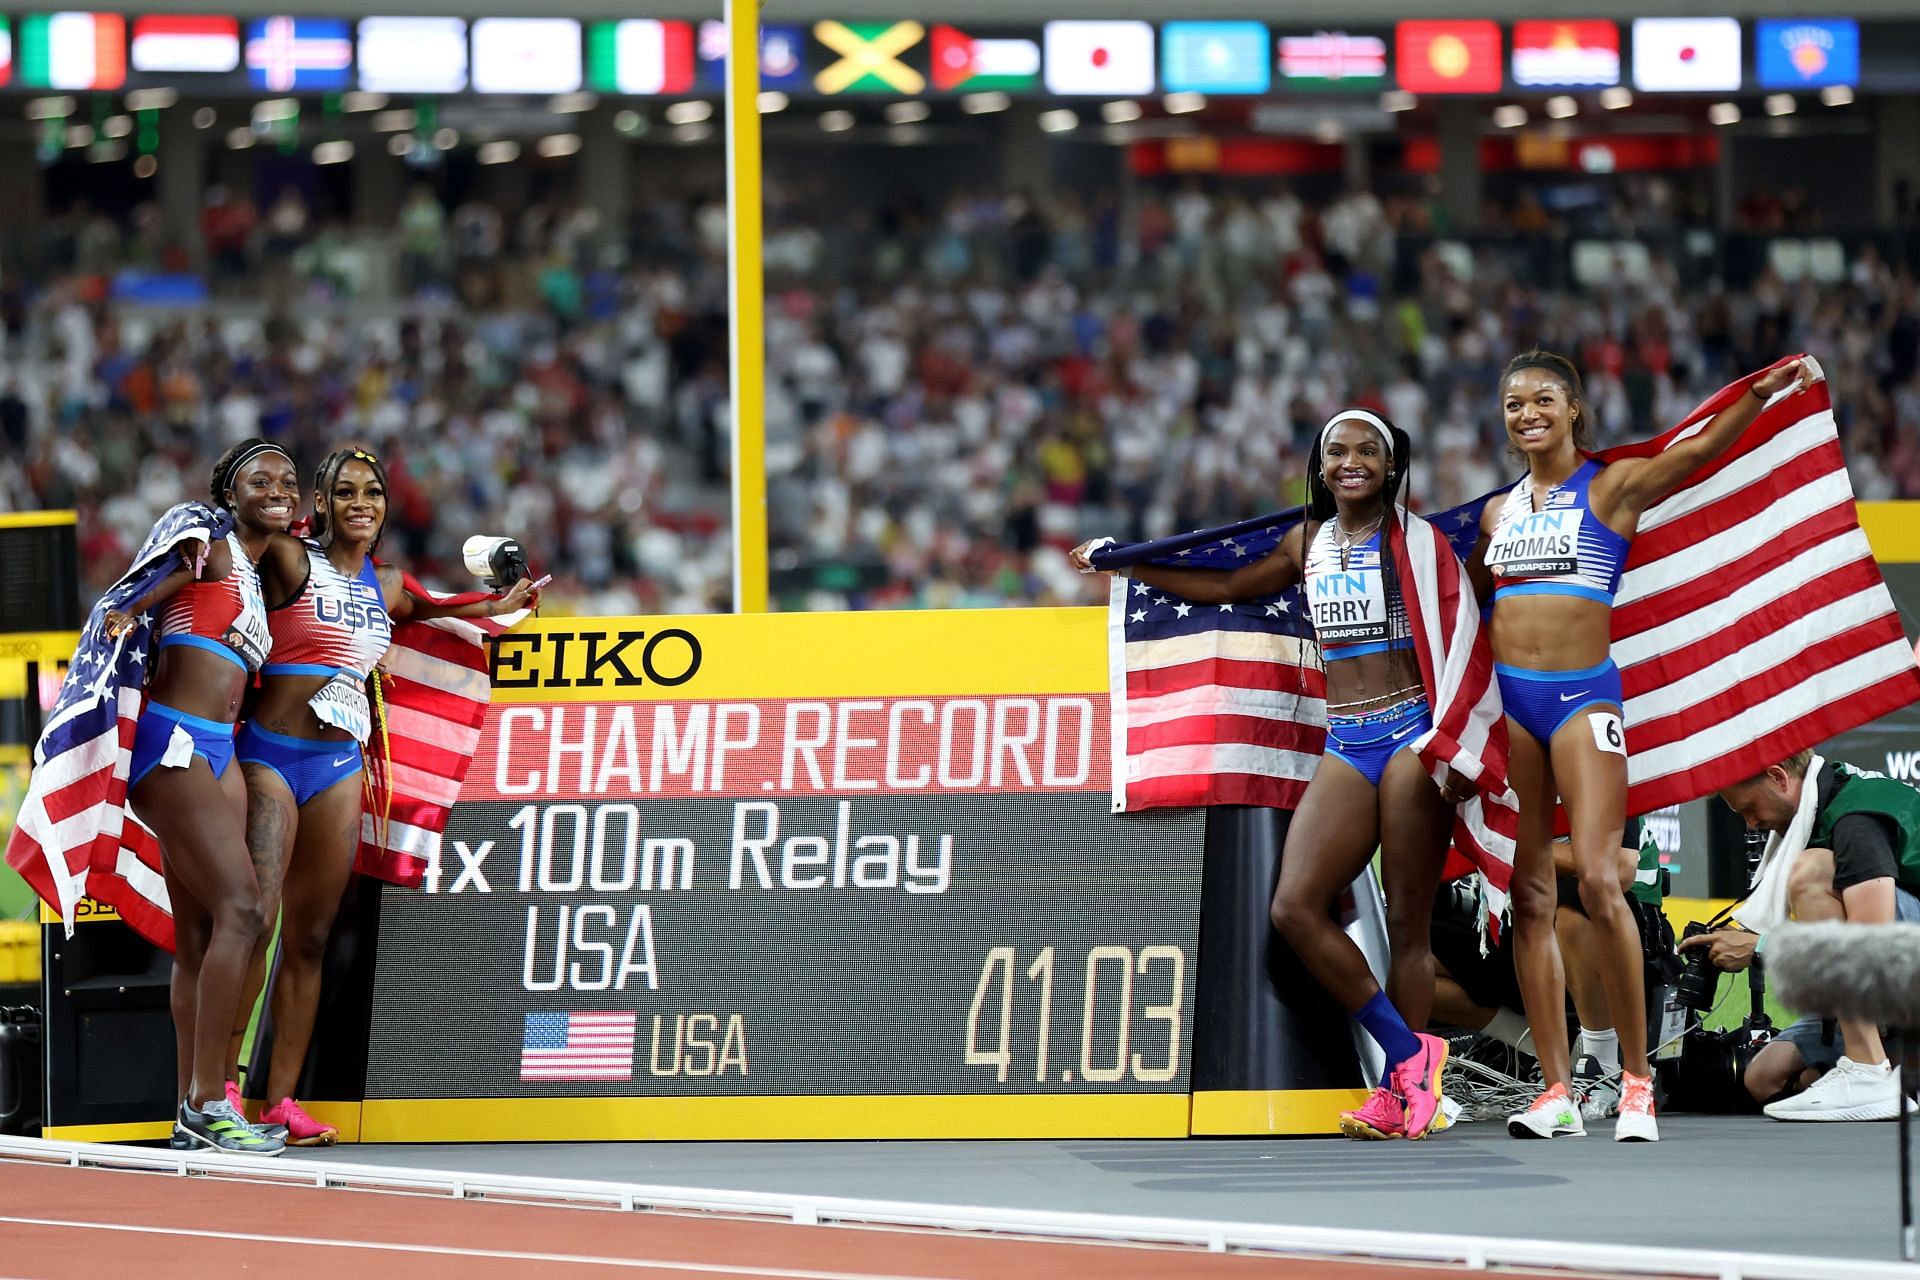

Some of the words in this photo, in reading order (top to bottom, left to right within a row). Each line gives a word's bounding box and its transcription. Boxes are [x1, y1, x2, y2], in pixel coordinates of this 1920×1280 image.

[1508, 511, 1565, 537] NTN
[1492, 534, 1571, 562] THOMAS
[1506, 562, 1558, 573] BUDAPEST
[1558, 562, 1572, 571] 23
[1316, 572, 1366, 598] NTN
[316, 597, 389, 633] USA
[1313, 599, 1371, 625] TERRY
[245, 614, 271, 655] DAVIS
[1321, 627, 1371, 639] BUDAPEST
[1371, 626, 1385, 635] 23
[483, 628, 703, 688] EIKO
[1606, 719, 1621, 748] 6
[729, 799, 954, 894] Relay
[523, 904, 660, 991] USA
[964, 945, 1185, 1083] 41.03
[650, 1013, 750, 1077] USA
